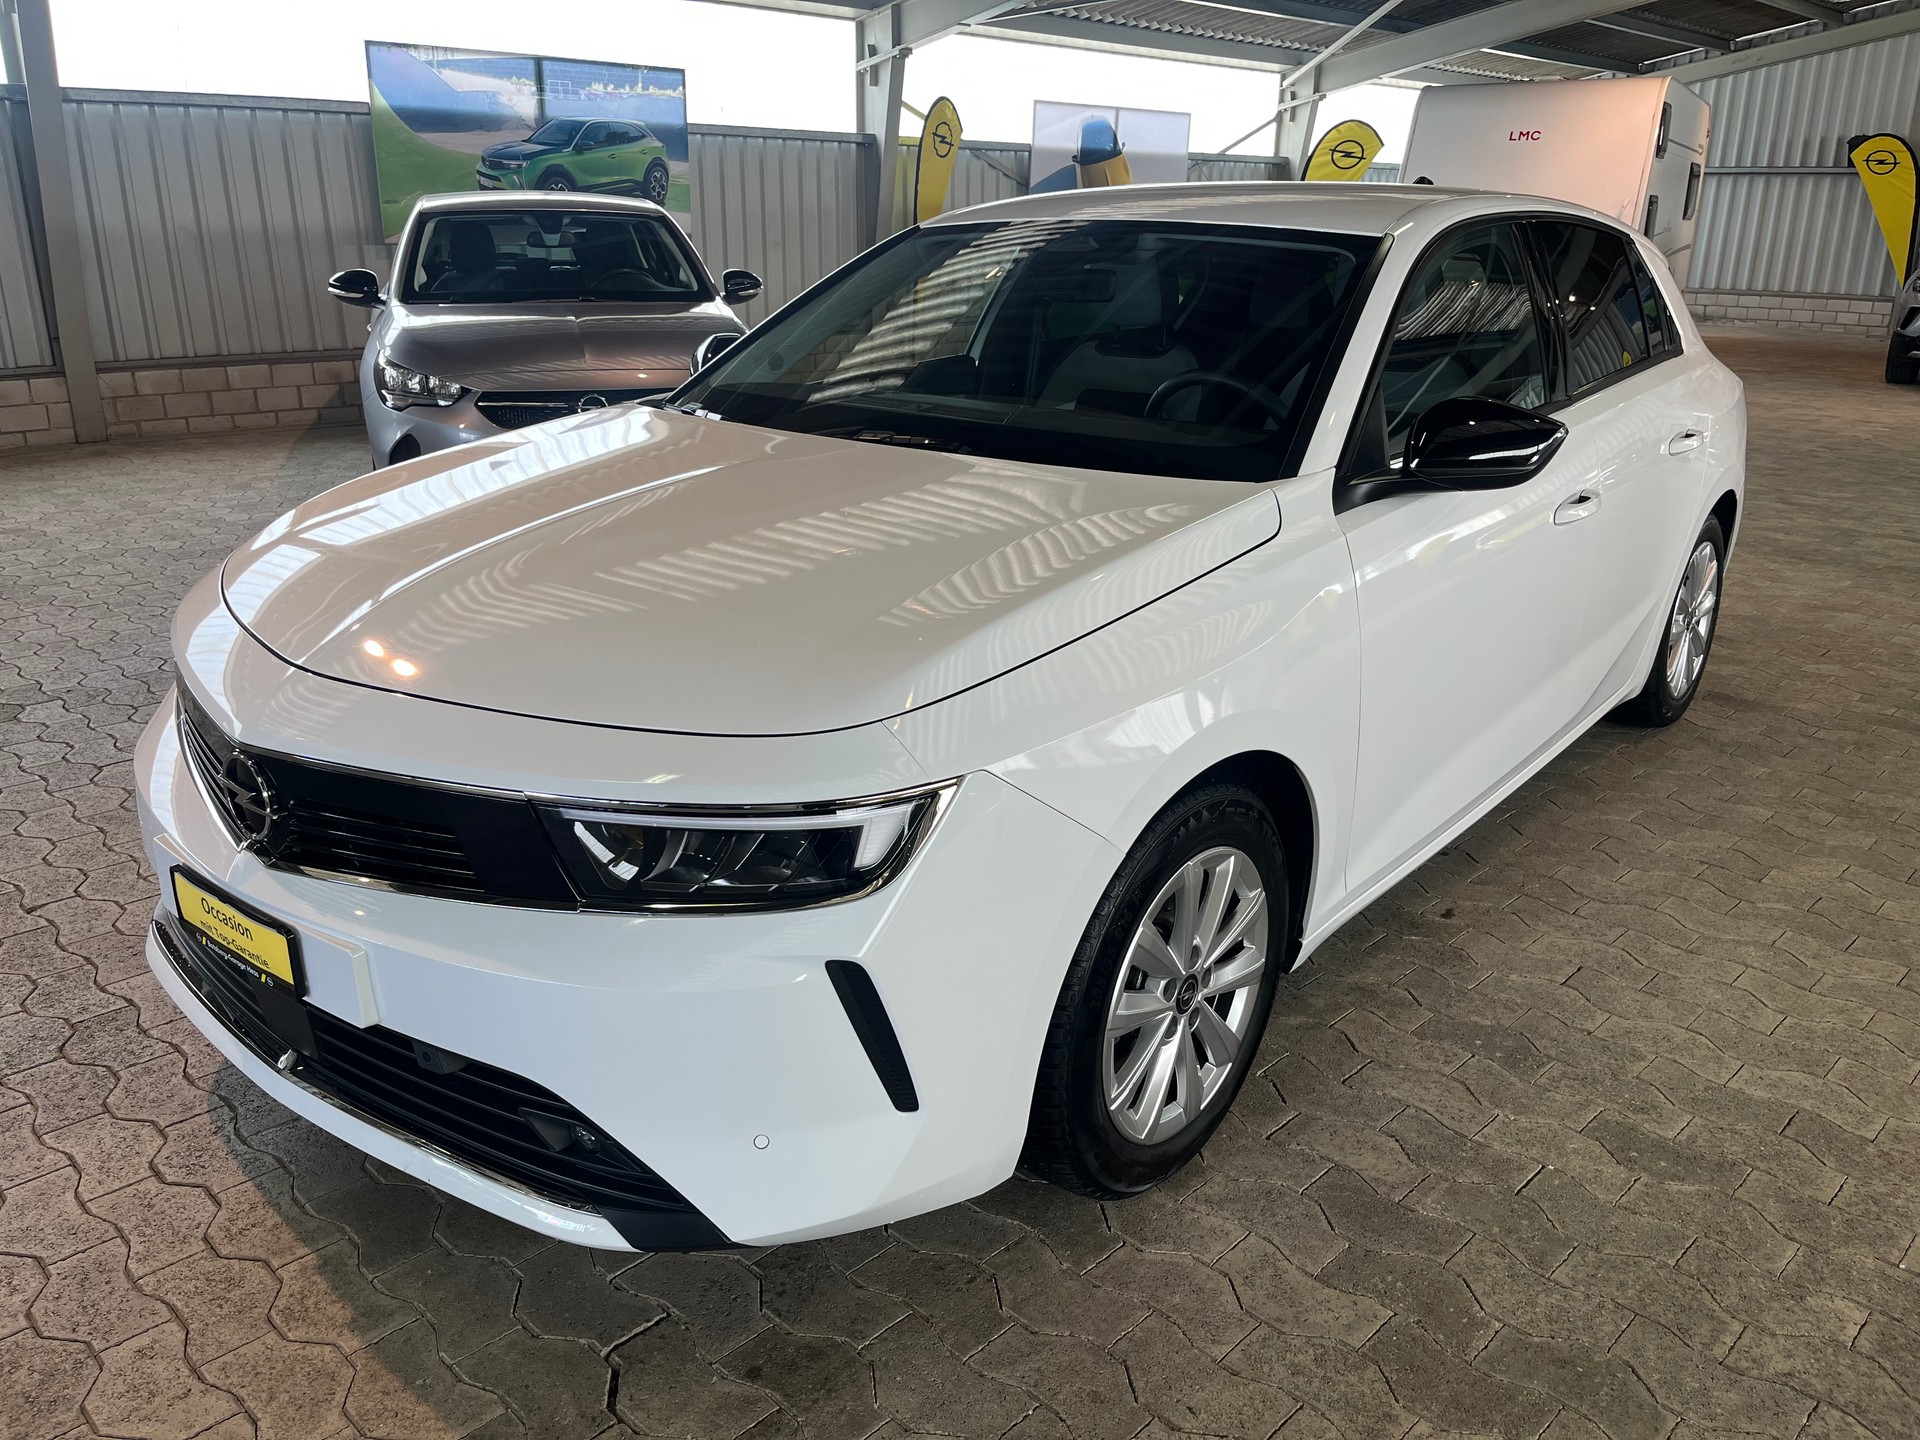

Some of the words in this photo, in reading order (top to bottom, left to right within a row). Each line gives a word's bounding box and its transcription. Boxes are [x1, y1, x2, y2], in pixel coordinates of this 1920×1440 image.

[1509, 130, 1542, 141] LMC
[201, 897, 254, 942] Occasion
[214, 926, 270, 969] Top-Garantie
